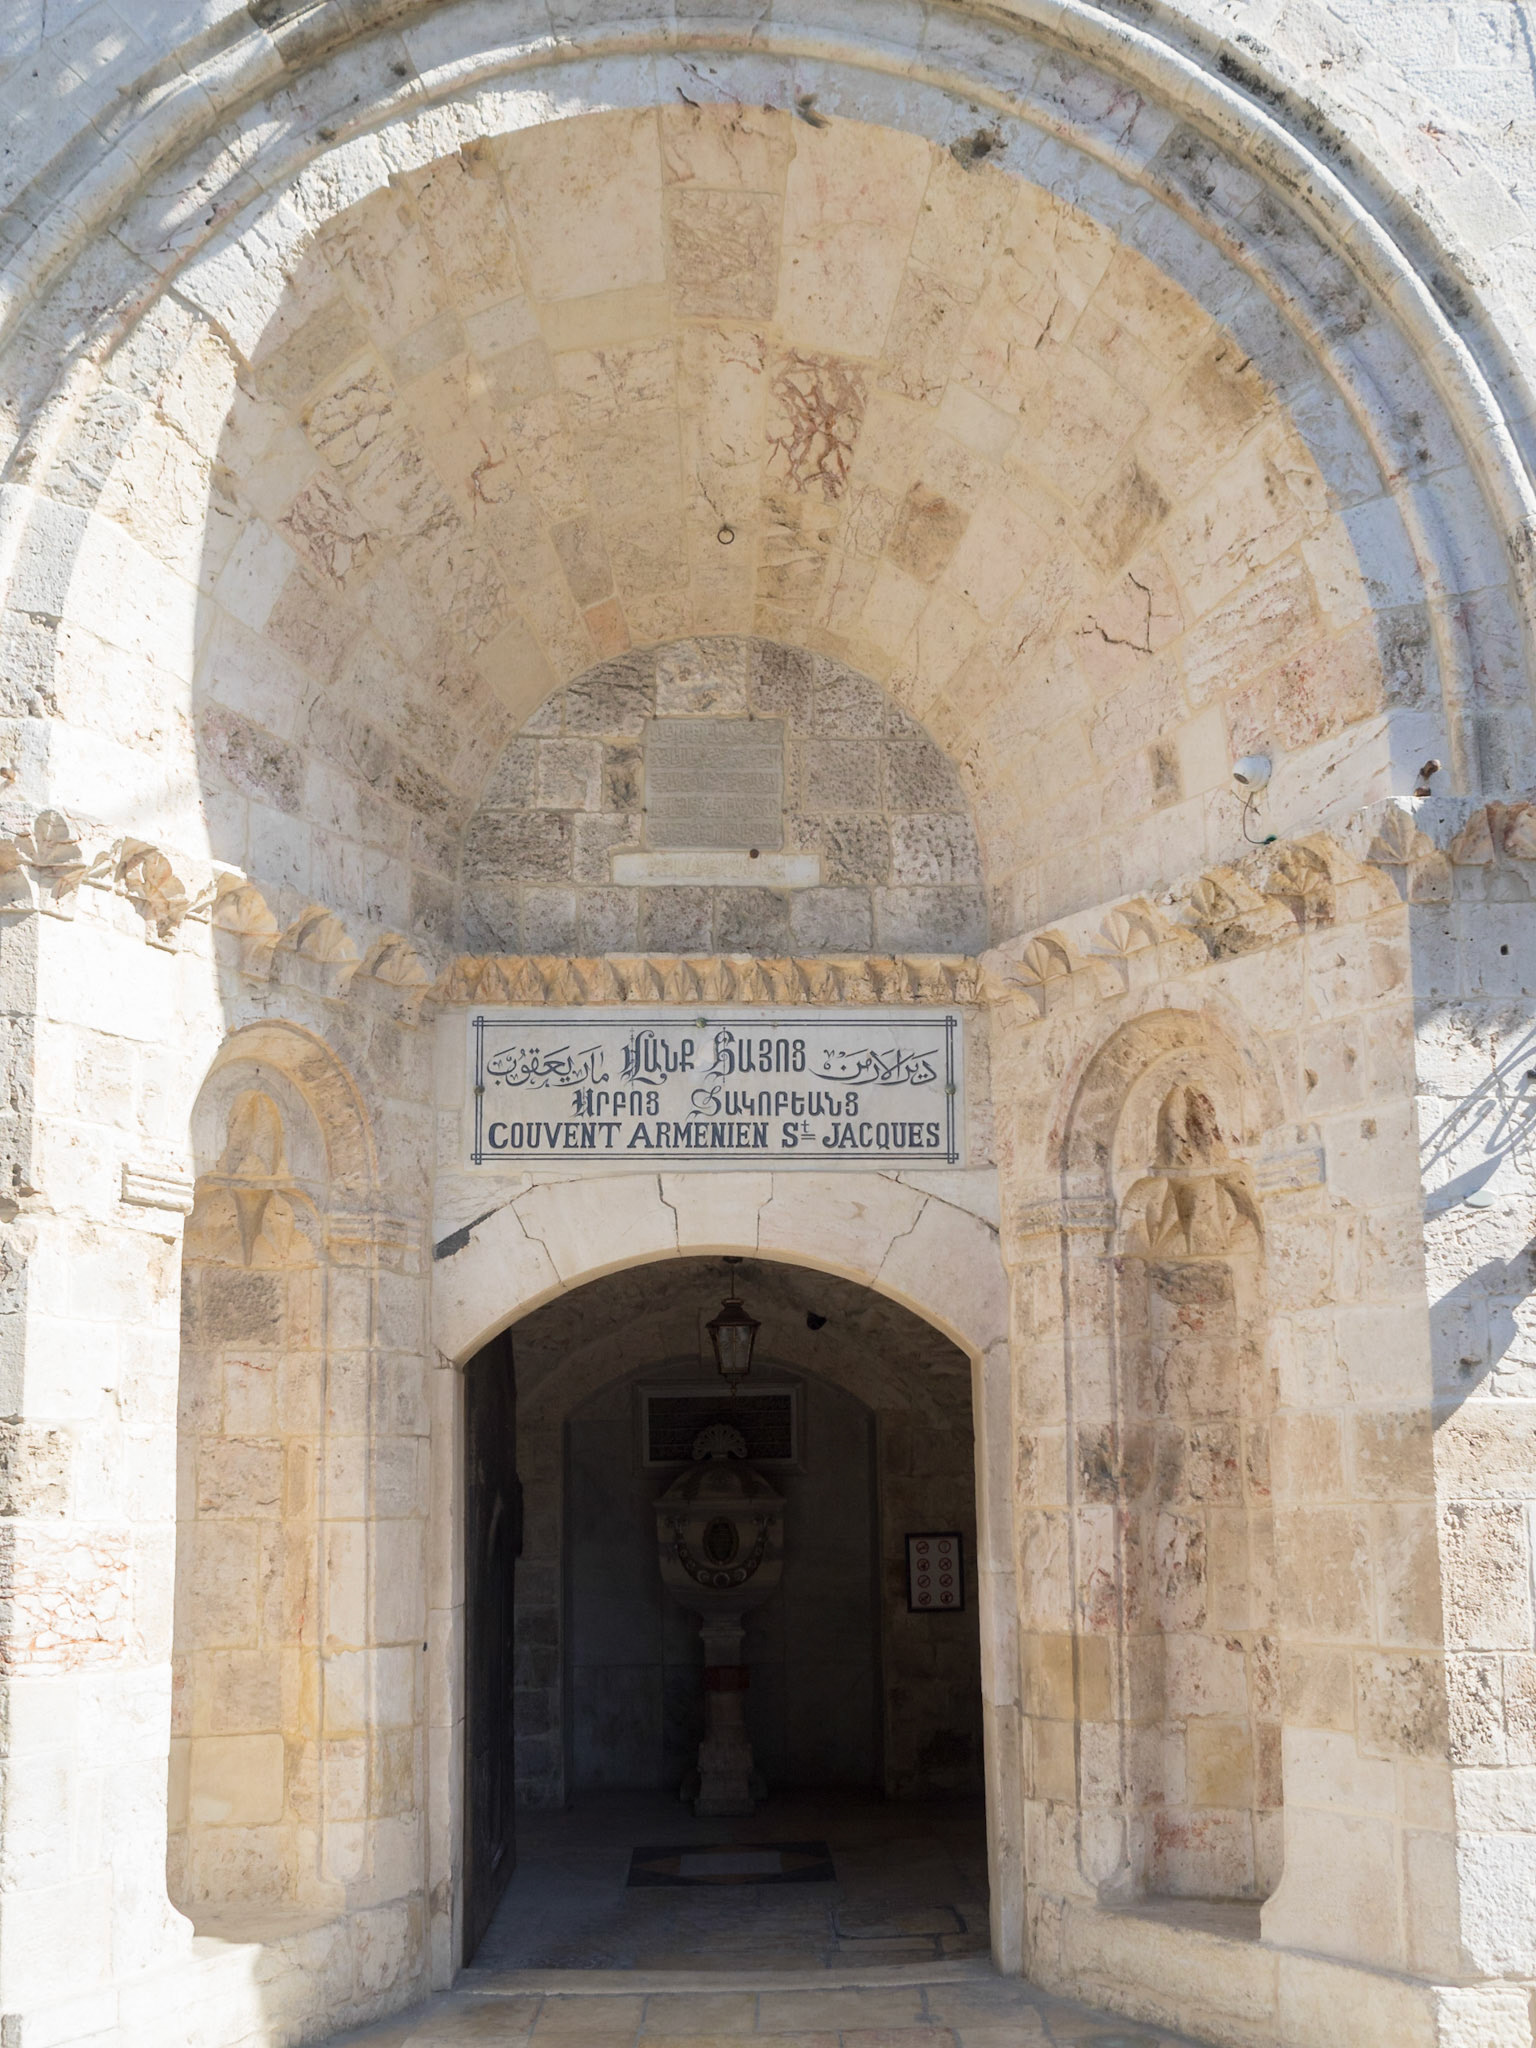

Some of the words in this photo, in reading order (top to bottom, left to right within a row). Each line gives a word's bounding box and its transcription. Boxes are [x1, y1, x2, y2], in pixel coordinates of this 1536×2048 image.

[488, 1121, 622, 1149] COUVENT
[626, 1121, 769, 1149] ARMENIEN
[822, 1121, 941, 1150] JACQUES
